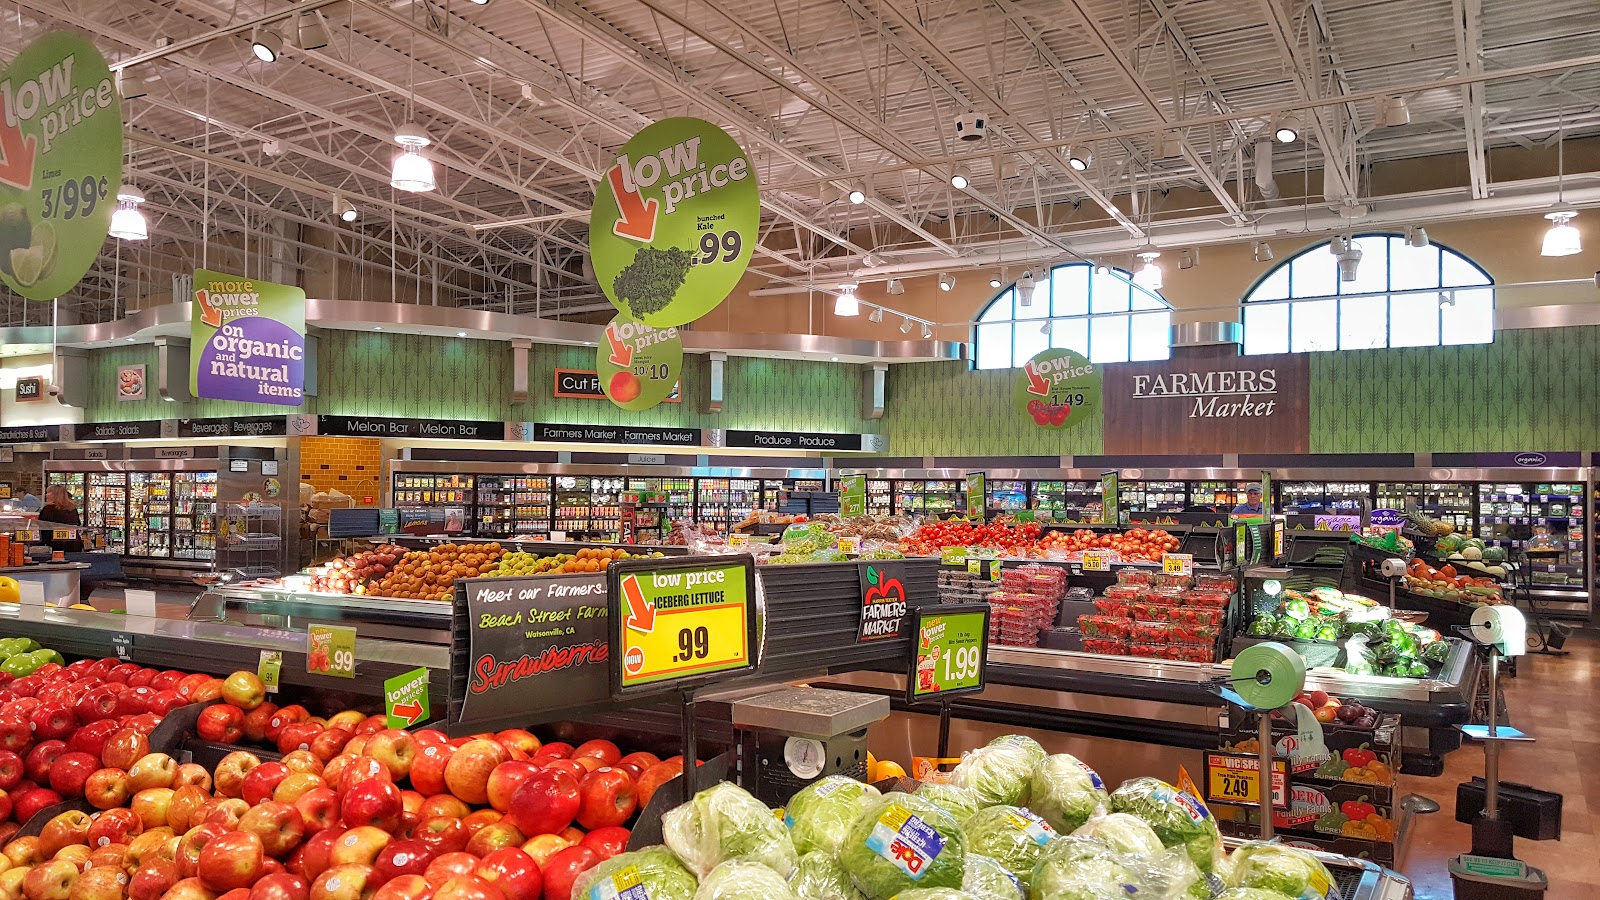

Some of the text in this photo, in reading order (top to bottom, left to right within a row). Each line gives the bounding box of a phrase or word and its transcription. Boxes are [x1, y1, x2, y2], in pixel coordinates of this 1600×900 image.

[1, 53, 76, 128] low
[41, 77, 113, 155] price
[616, 135, 701, 194] low
[42, 169, 62, 180] Limes
[662, 156, 748, 215] price
[696, 213, 725, 222] bunched
[696, 222, 714, 231] Kale
[690, 230, 742, 265] .99
[208, 280, 254, 292] more
[203, 289, 260, 307] lower
[222, 306, 259, 320] prices
[222, 325, 244, 338] on
[634, 327, 677, 353] price
[212, 335, 303, 360] organic
[215, 353, 236, 362] and
[1029, 355, 1071, 376] low
[210, 360, 289, 383] natural
[1052, 364, 1093, 385] price
[19, 382, 37, 395] Sushi
[257, 380, 302, 398] items
[562, 376, 588, 390] Cut
[1132, 368, 1278, 397] FARMERS
[1051, 393, 1084, 407] 1.49
[1188, 393, 1277, 418] Market
[95, 424, 140, 436] Salads Salads
[192, 421, 273, 435] Beverages Beverages
[347, 420, 478, 436] Melon Bar Melon Bar
[543, 427, 693, 442] Farmers Market Farmers Market
[754, 434, 836, 447] Produce Produce
[638, 455, 656, 463] Juice
[1517, 456, 1544, 464] organic
[652, 567, 725, 590] low price
[476, 587, 513, 602] Meet
[518, 587, 542, 601] our
[653, 590, 725, 609] ICEBERG LETTUCE
[479, 607, 522, 629] Beach
[527, 608, 572, 625] Street
[863, 601, 907, 620] FARMERS
[863, 618, 902, 636] MARKET
[922, 622, 947, 638] lower
[926, 616, 942, 629] new
[313, 632, 333, 641] lower
[525, 626, 576, 639] Watsonville, CA
[672, 625, 710, 663] .99
[330, 649, 353, 671] .99
[625, 653, 642, 665] NOW
[942, 645, 980, 681] 1.99
[387, 674, 424, 703] lower
[400, 686, 424, 706] prices
[1224, 758, 1240, 769] VIC
[1223, 778, 1249, 797] 2.49
[1306, 803, 1332, 814] Farms
[889, 840, 924, 874] Dole
